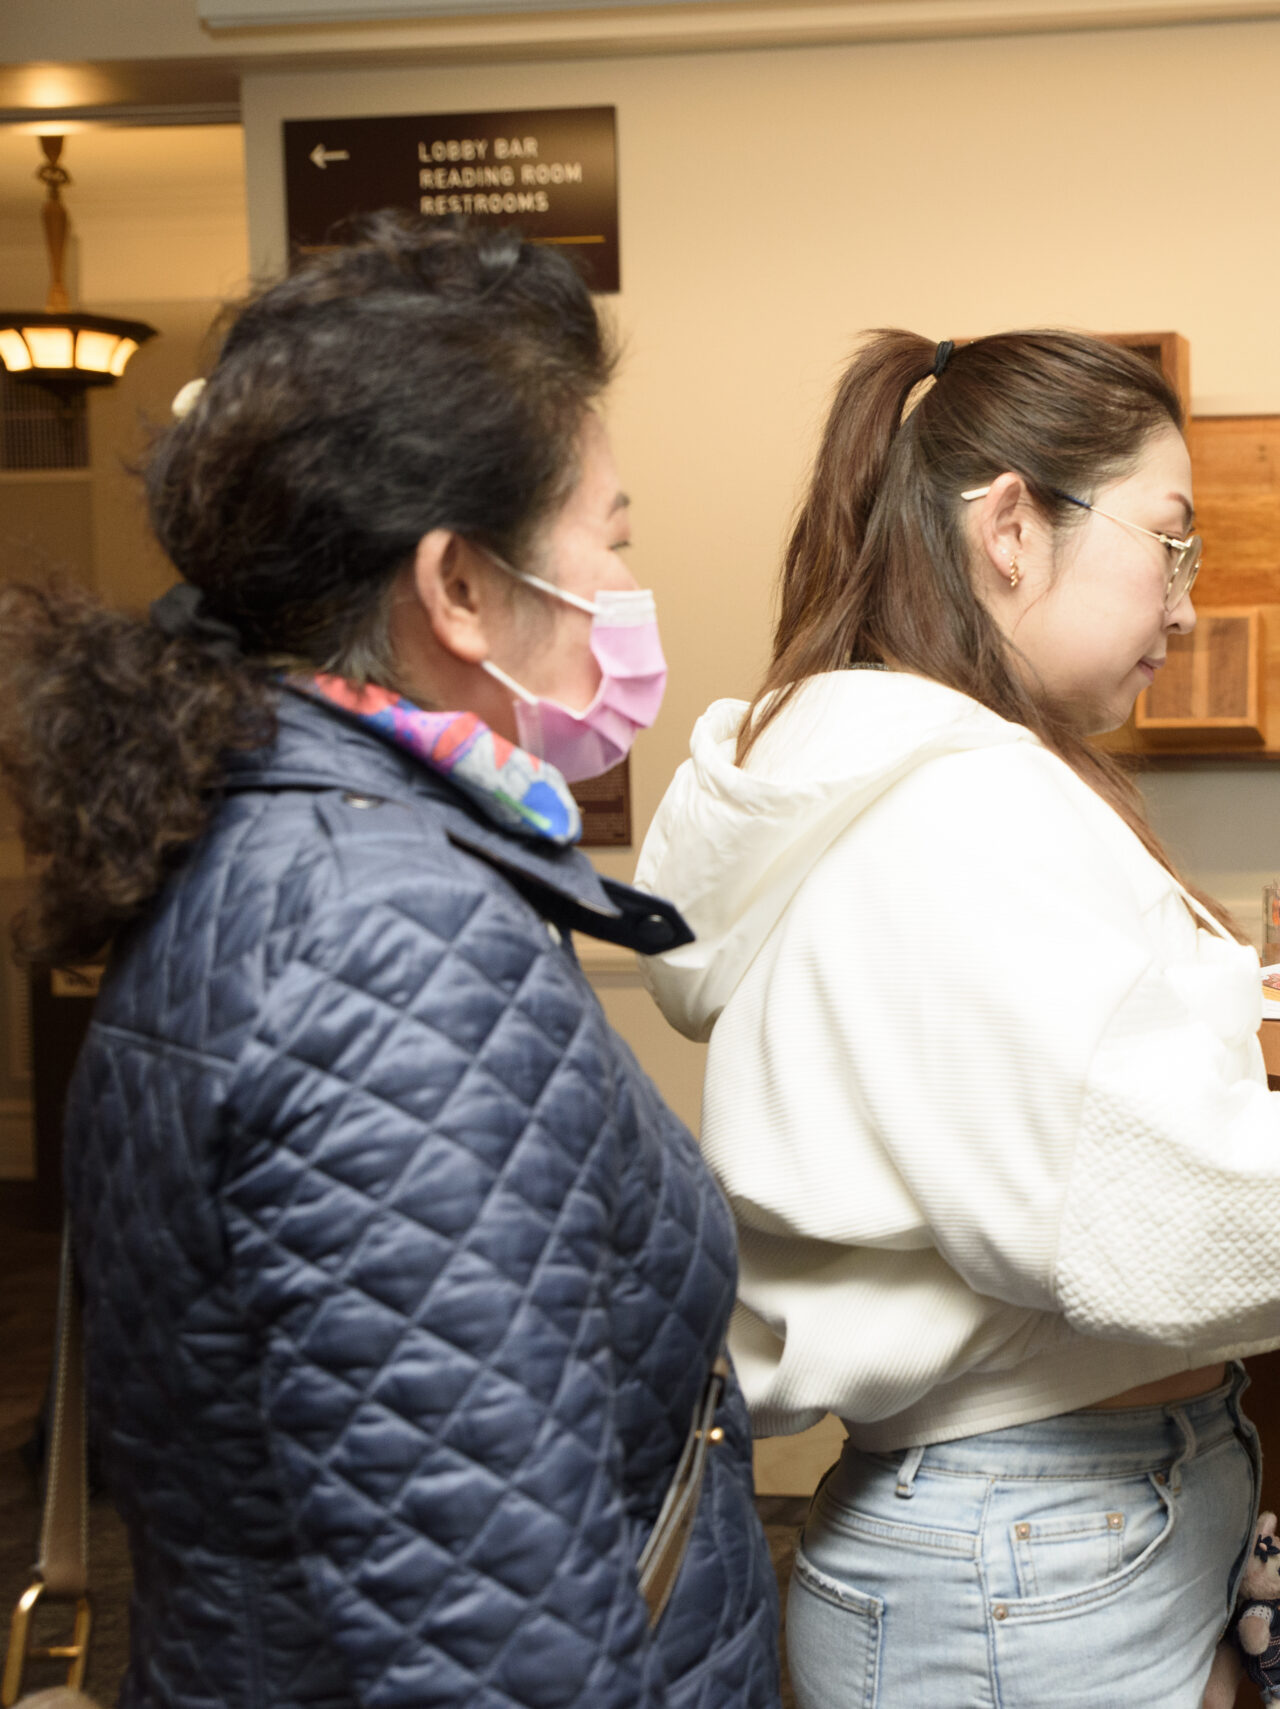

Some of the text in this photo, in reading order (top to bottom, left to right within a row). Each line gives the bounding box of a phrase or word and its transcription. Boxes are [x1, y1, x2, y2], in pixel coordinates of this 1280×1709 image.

[418, 136, 538, 163] LOBBY BAR
[419, 162, 582, 190] READING ROOM
[420, 191, 549, 215] RESTROOMS
